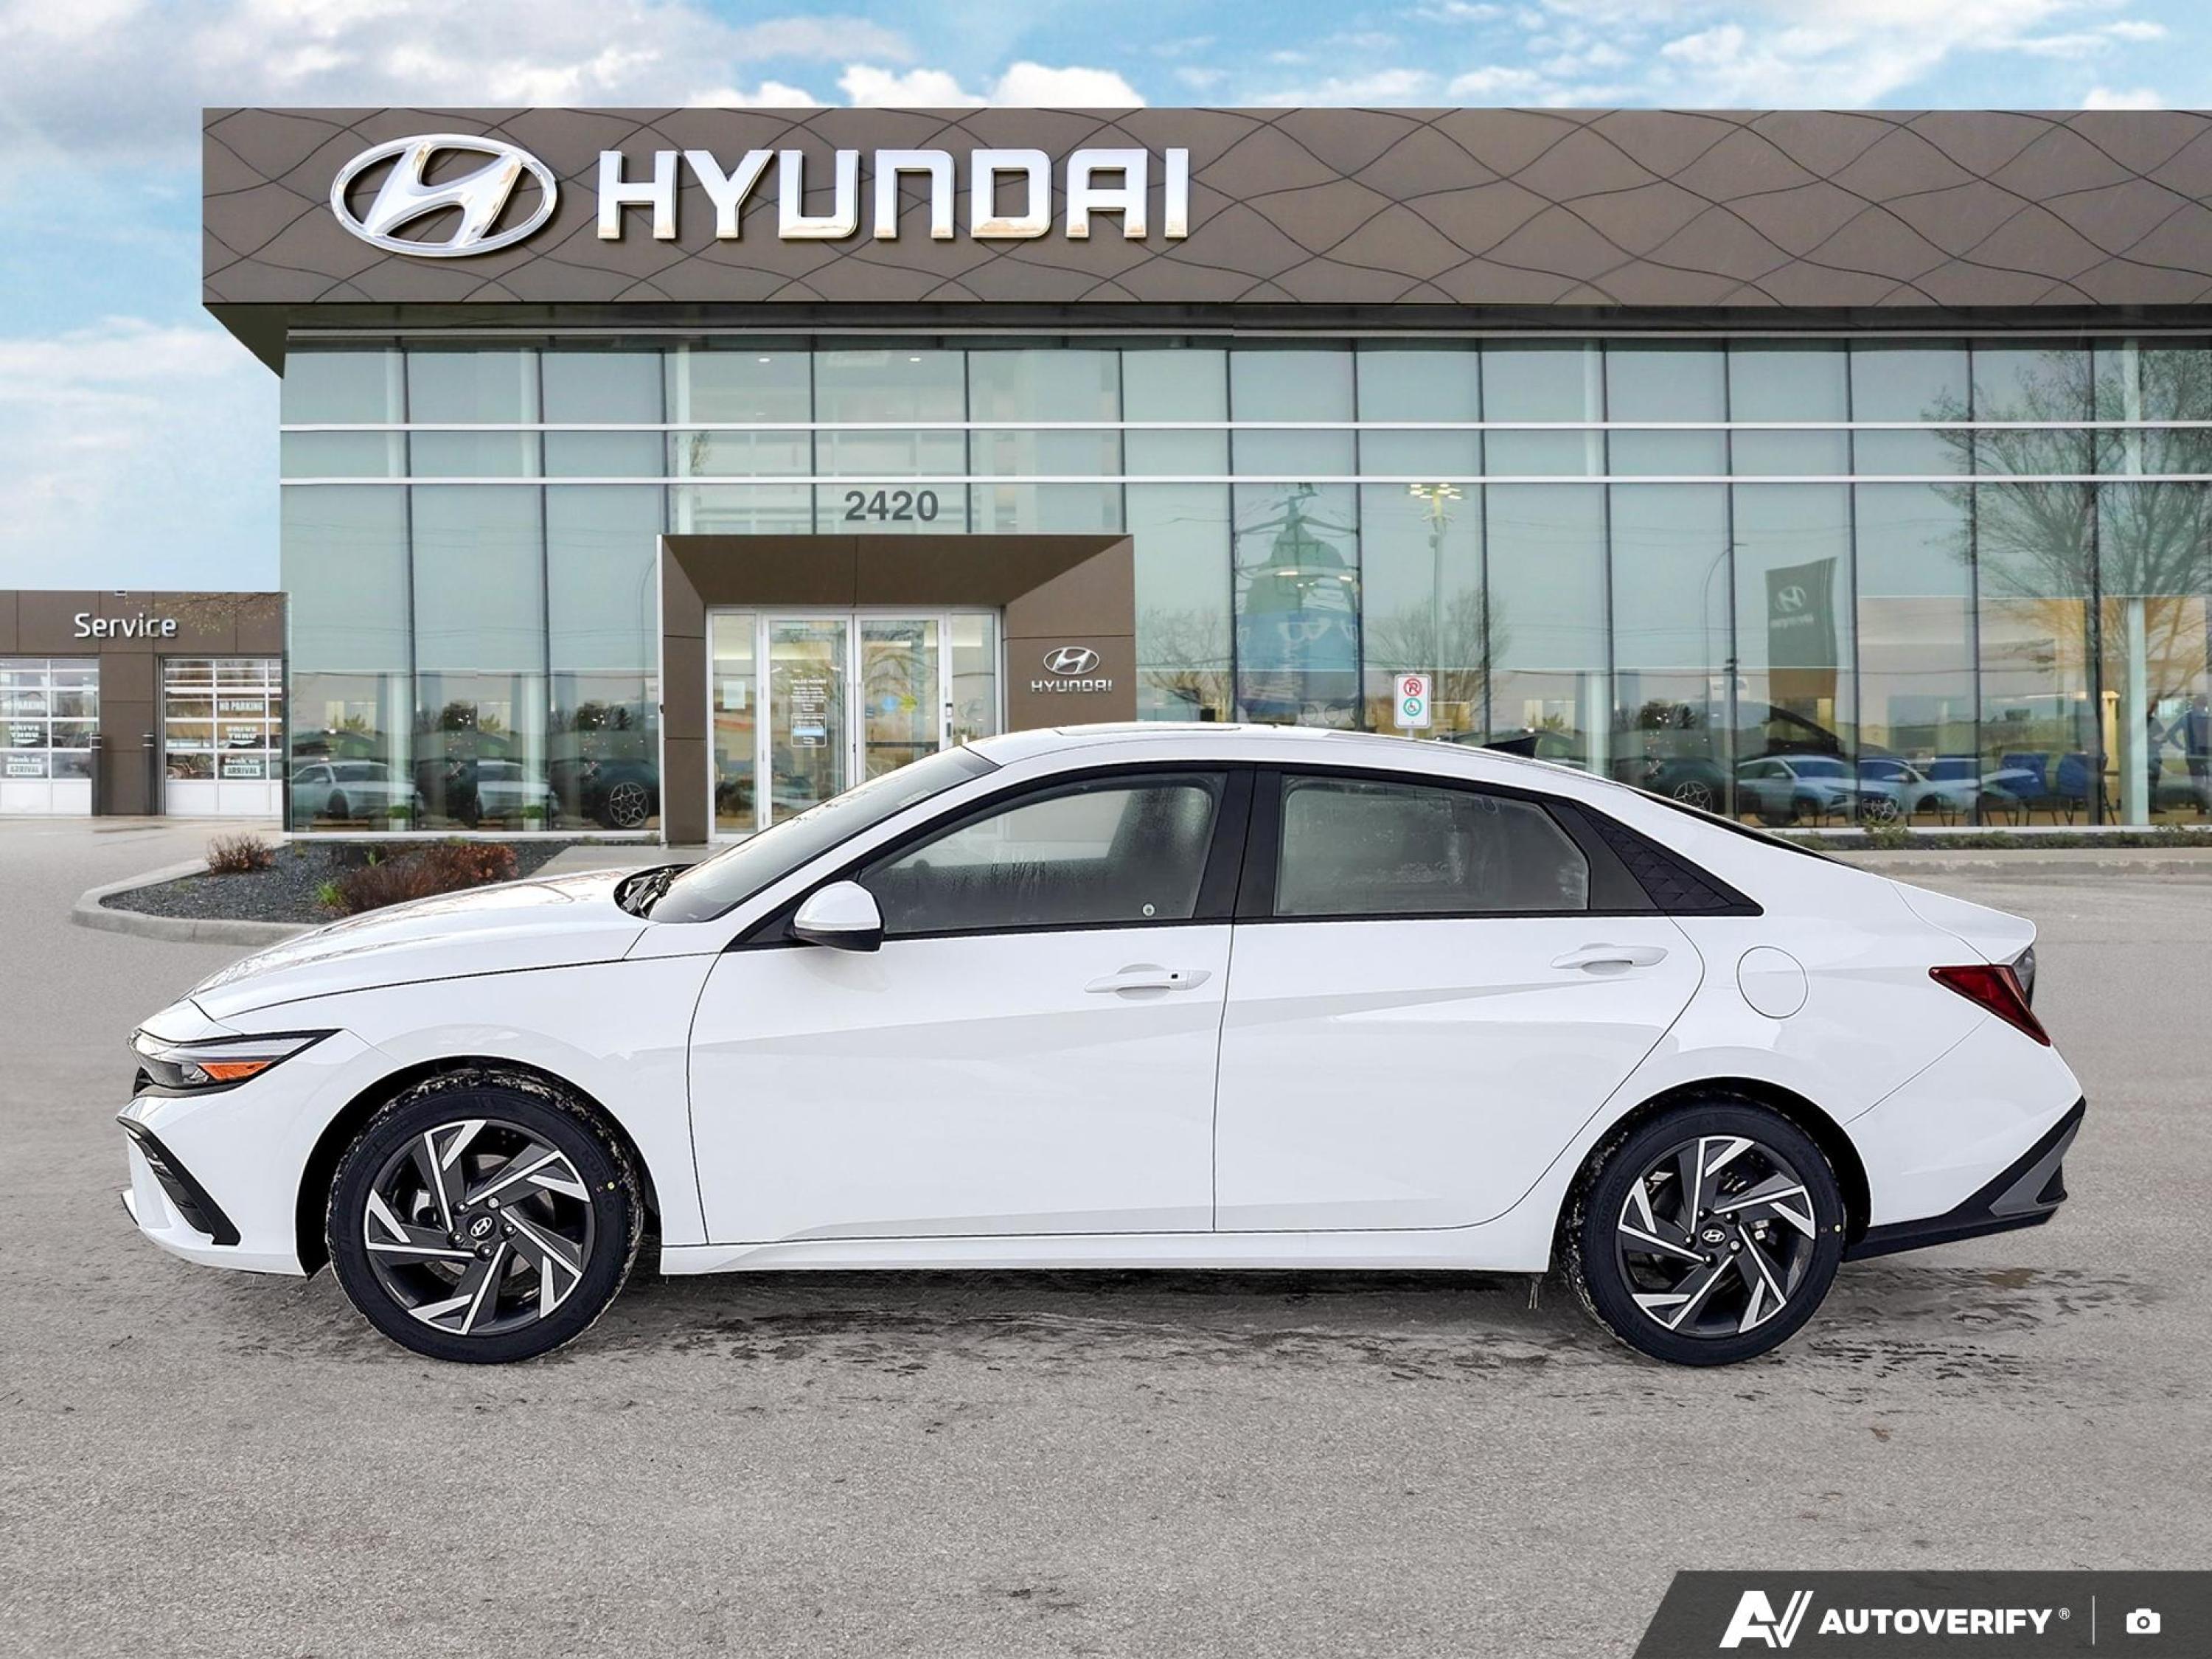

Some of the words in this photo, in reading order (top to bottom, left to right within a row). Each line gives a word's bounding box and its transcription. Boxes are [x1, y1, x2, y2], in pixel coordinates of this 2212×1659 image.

[597, 147, 1190, 241] HYUNDAI
[844, 490, 939, 522] 2420
[74, 613, 178, 639] Service
[1032, 679, 1113, 692] HYUNDAI
[231, 701, 264, 711] PARKING
[227, 766, 258, 774] ARRIVAL
